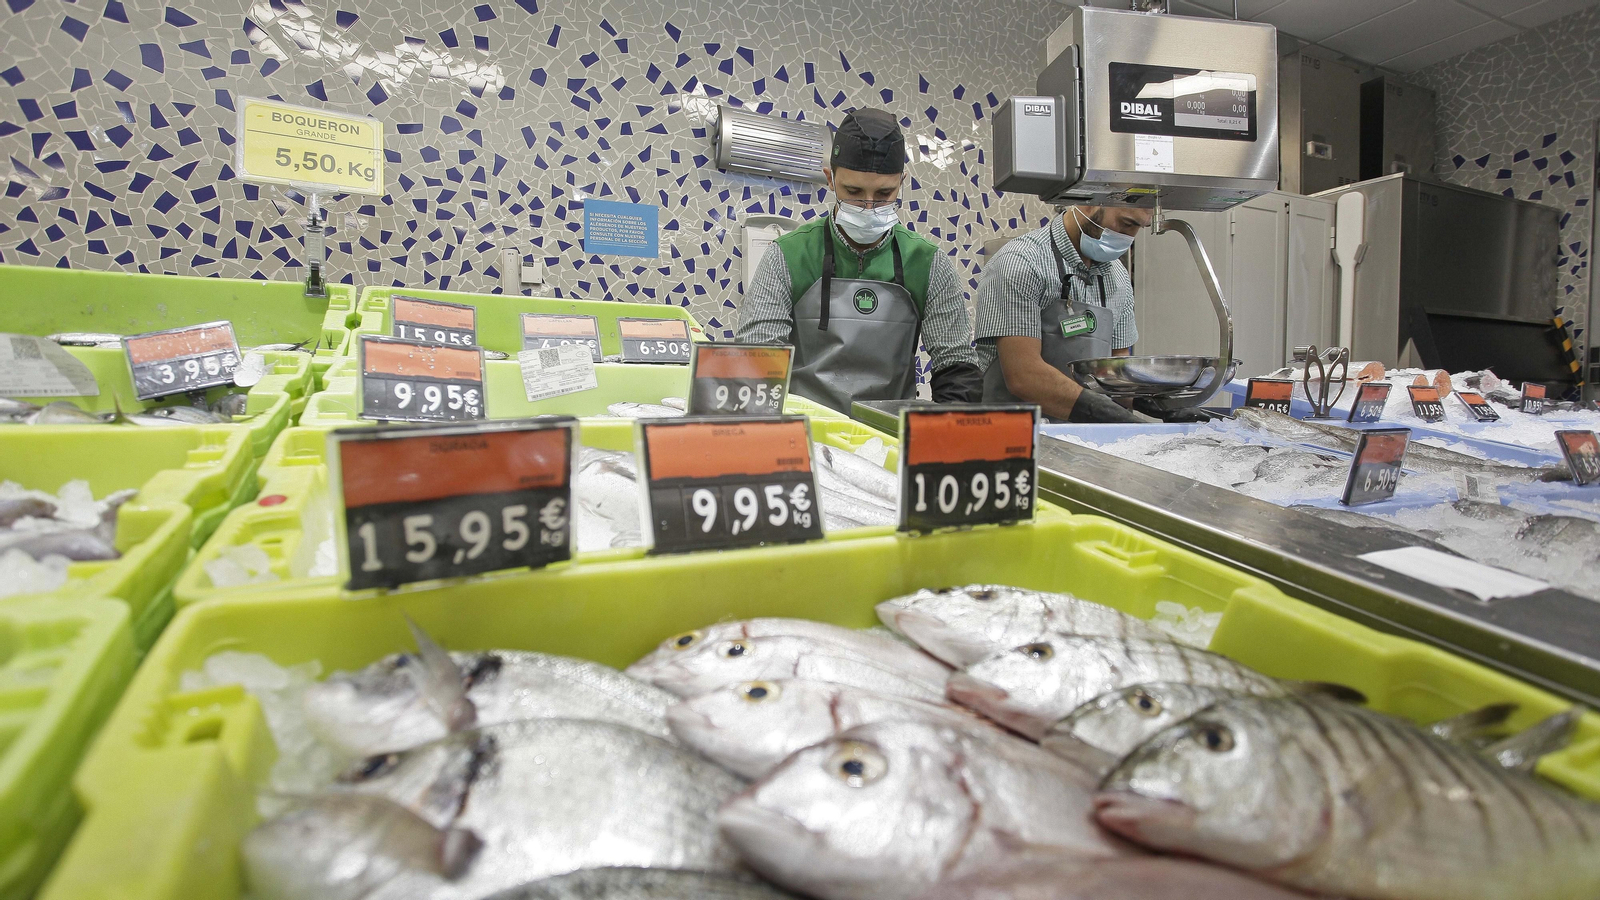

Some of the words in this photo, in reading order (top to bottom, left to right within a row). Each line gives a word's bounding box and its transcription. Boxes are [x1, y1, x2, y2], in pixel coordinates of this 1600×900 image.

[1121, 102, 1162, 116] DIBAL
[1232, 104, 1246, 113] 0,00
[271, 111, 360, 136] BOQUERON
[296, 128, 336, 141] GRANDE
[348, 161, 376, 182] Kg
[465, 404, 479, 415] kg
[768, 399, 779, 409] kg
[956, 418, 992, 426] HERRERA
[1015, 494, 1029, 510] kg
[793, 510, 812, 529] kg
[540, 529, 564, 547] kg
